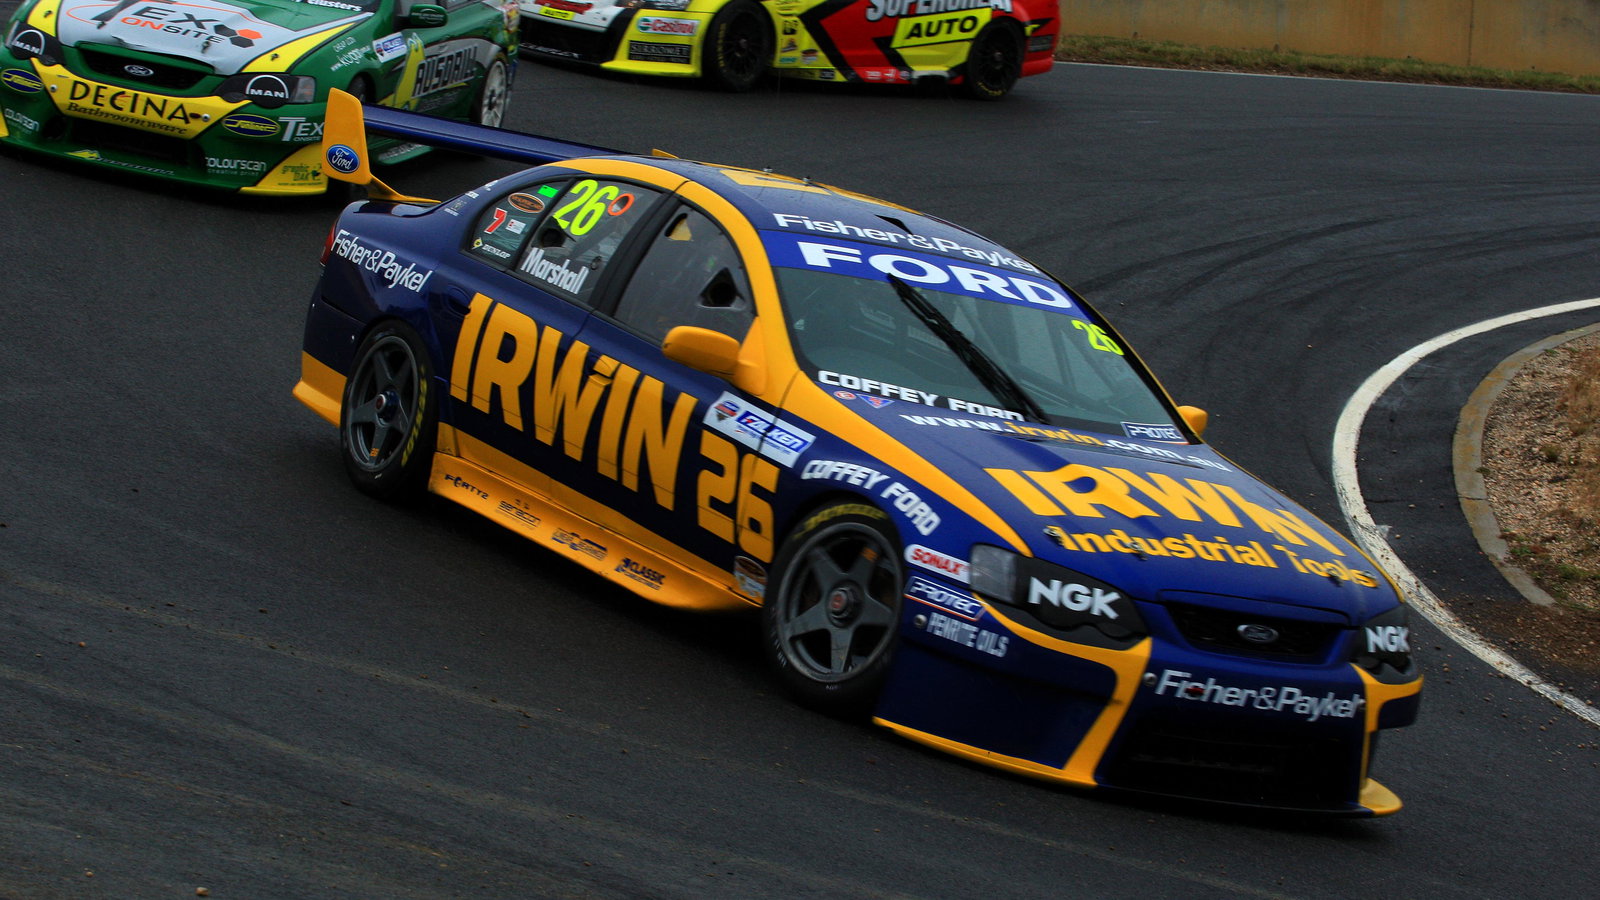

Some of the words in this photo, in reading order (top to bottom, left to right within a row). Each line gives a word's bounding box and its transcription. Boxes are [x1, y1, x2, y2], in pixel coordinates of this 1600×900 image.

[120, 16, 226, 44] ONSITE
[652, 19, 695, 34] Castrol
[904, 16, 978, 39] AUTO
[13, 39, 41, 54] MAN
[69, 80, 191, 125] DECINA
[251, 88, 286, 98] MAN
[67, 102, 188, 135] Bathroomware
[278, 116, 325, 142] TEX
[332, 147, 354, 170] Ford
[484, 207, 508, 235] 7
[552, 179, 620, 236] 26
[330, 229, 433, 293] Fisher&Paykel
[773, 213, 1043, 275] Fisher&Paykel
[520, 247, 590, 295] Marshall
[797, 241, 1073, 309] FORD
[1071, 320, 1125, 356] 26
[450, 292, 699, 511] IRWIN
[818, 370, 939, 406] COFFEY
[947, 397, 1026, 422] FORD
[740, 413, 805, 451] FALKEN
[899, 414, 1232, 472] www.irwin.com.au
[697, 430, 780, 564] 26
[801, 459, 890, 489] COFFEY
[880, 482, 941, 536] FORD
[983, 463, 1346, 557] IRWIN
[911, 548, 964, 575] SONAX
[1046, 525, 1279, 569] Industrial
[1273, 543, 1379, 589] Tools
[911, 581, 982, 615] PROTEC
[1028, 576, 1121, 620] NGK
[976, 626, 1010, 658] OILS
[1365, 626, 1410, 653] NGK
